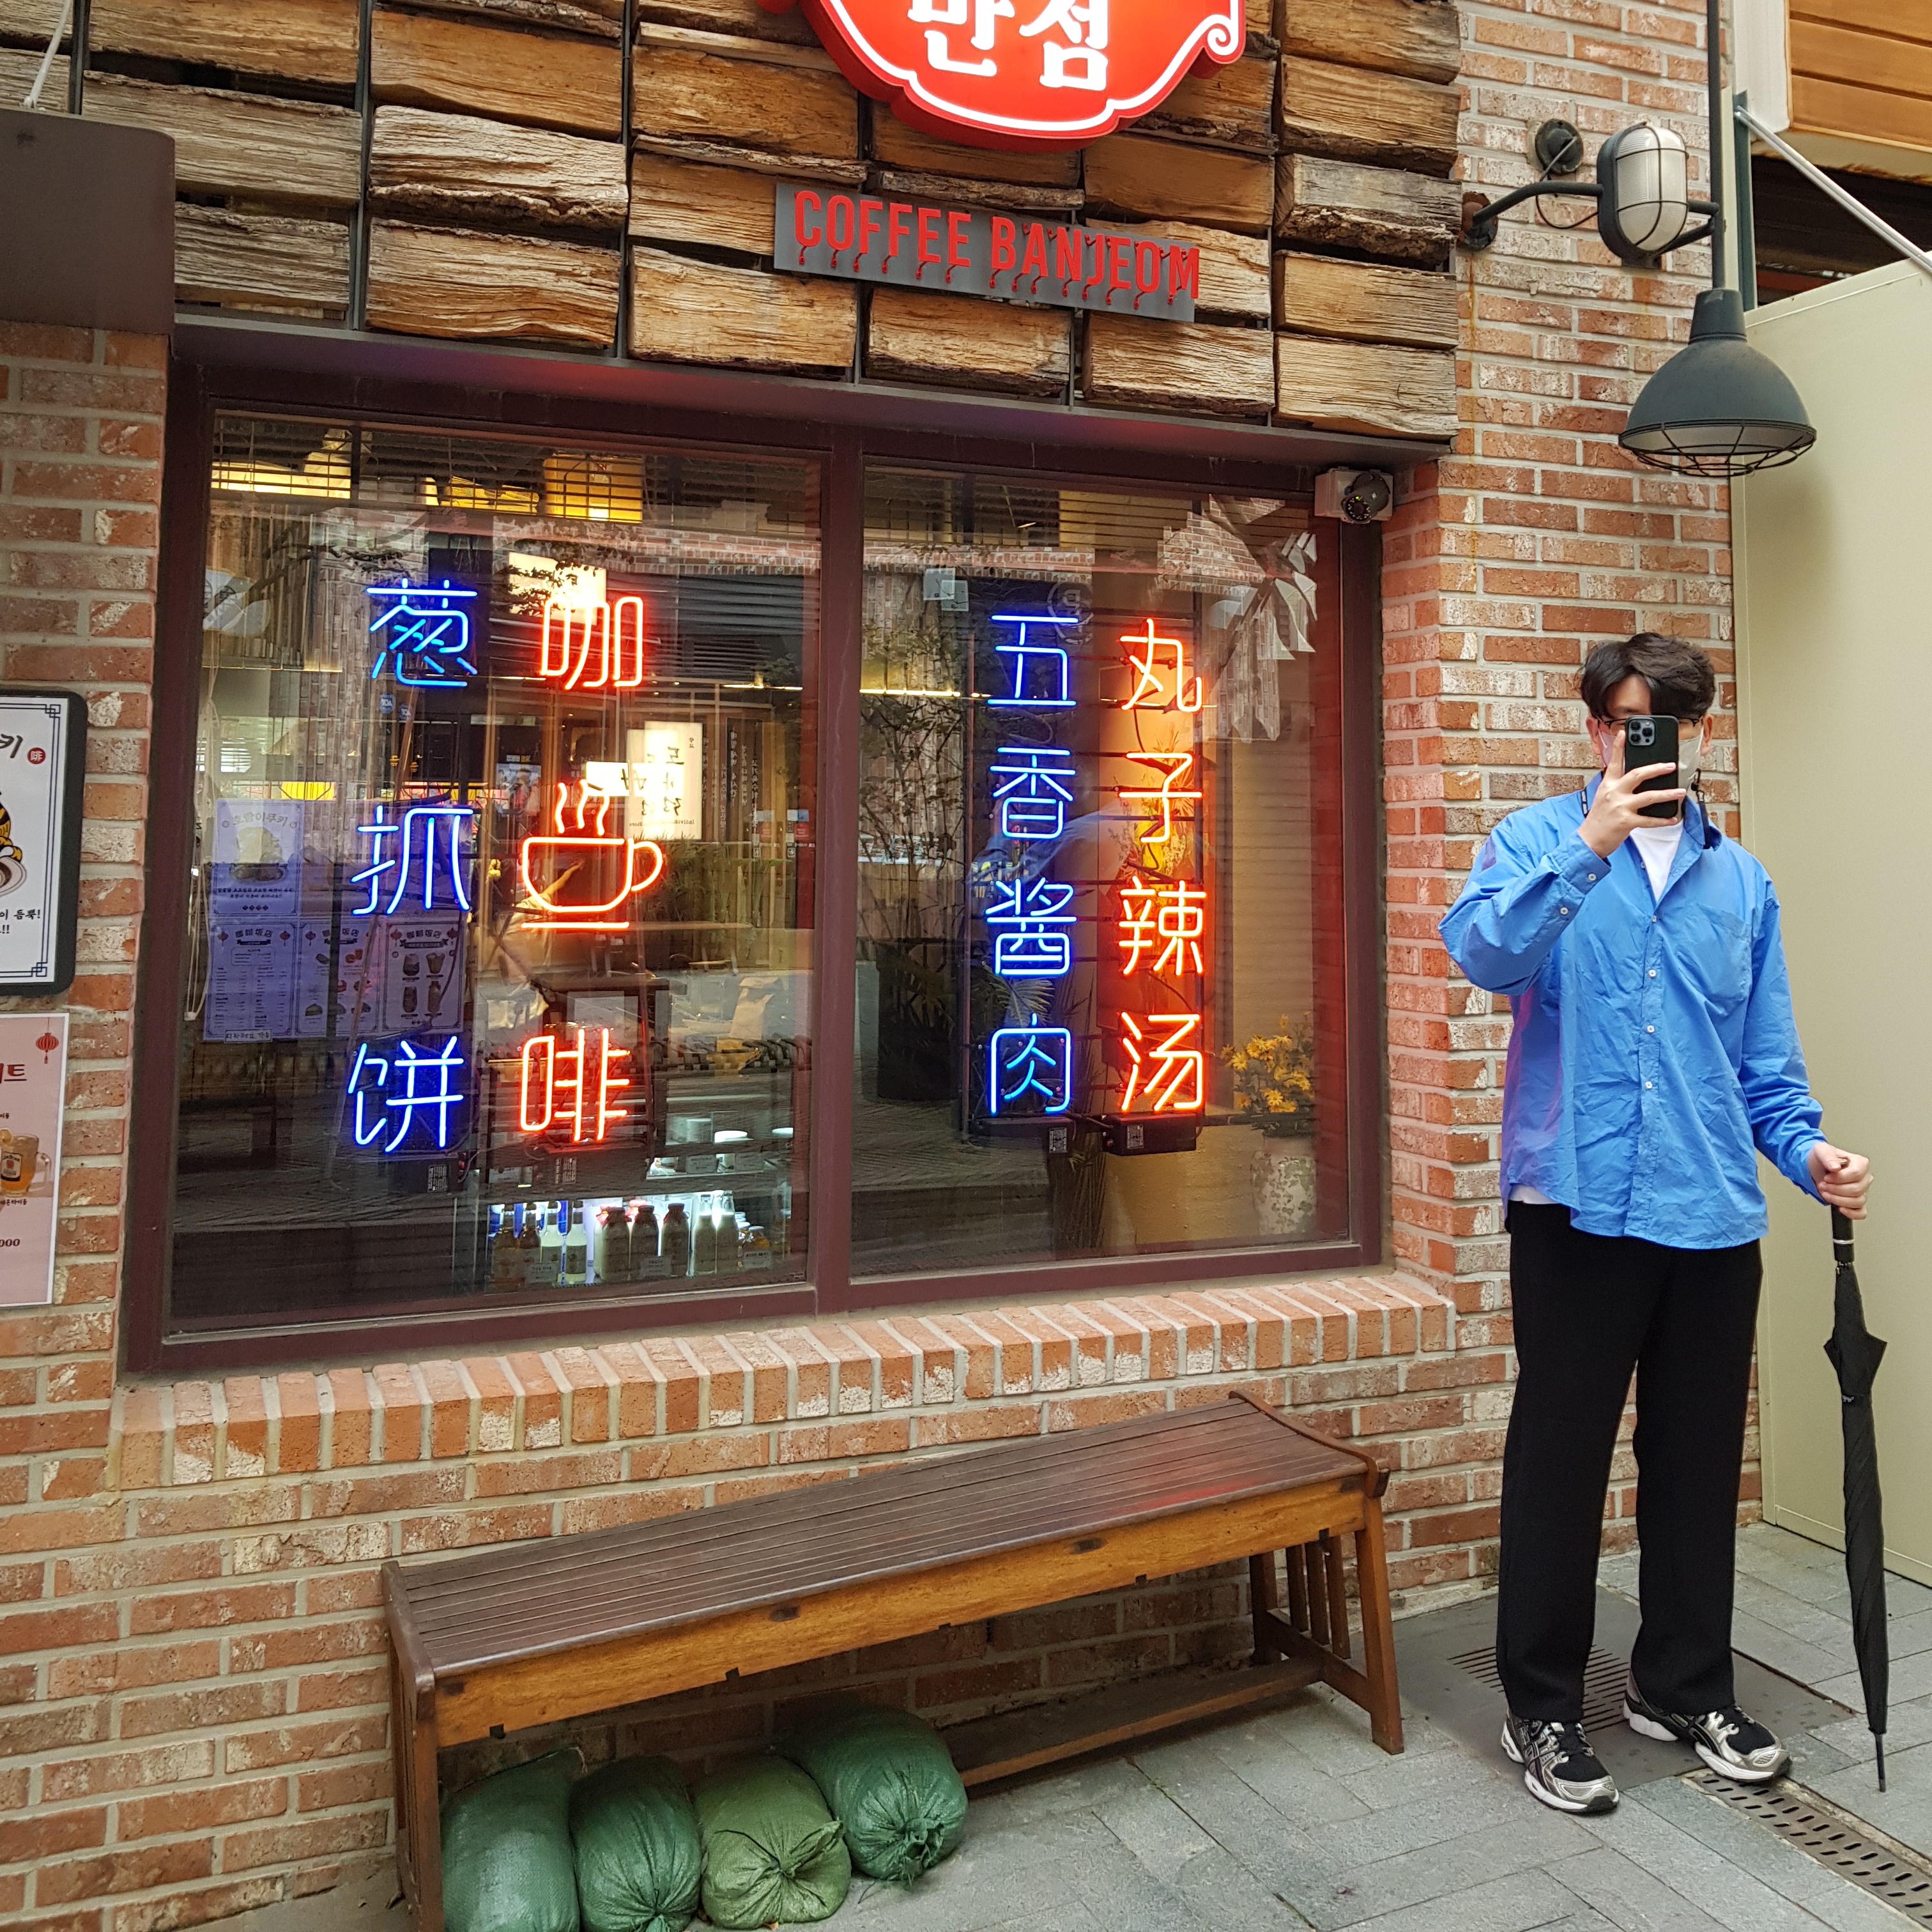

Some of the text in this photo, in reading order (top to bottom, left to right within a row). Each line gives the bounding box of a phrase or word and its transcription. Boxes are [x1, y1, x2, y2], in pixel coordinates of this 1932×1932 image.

[793, 189, 1200, 299] COFFEE BANJEOM
[13, 908, 41, 920] 듬뿍!
[1117, 617, 1208, 1112] 丸子辣汤
